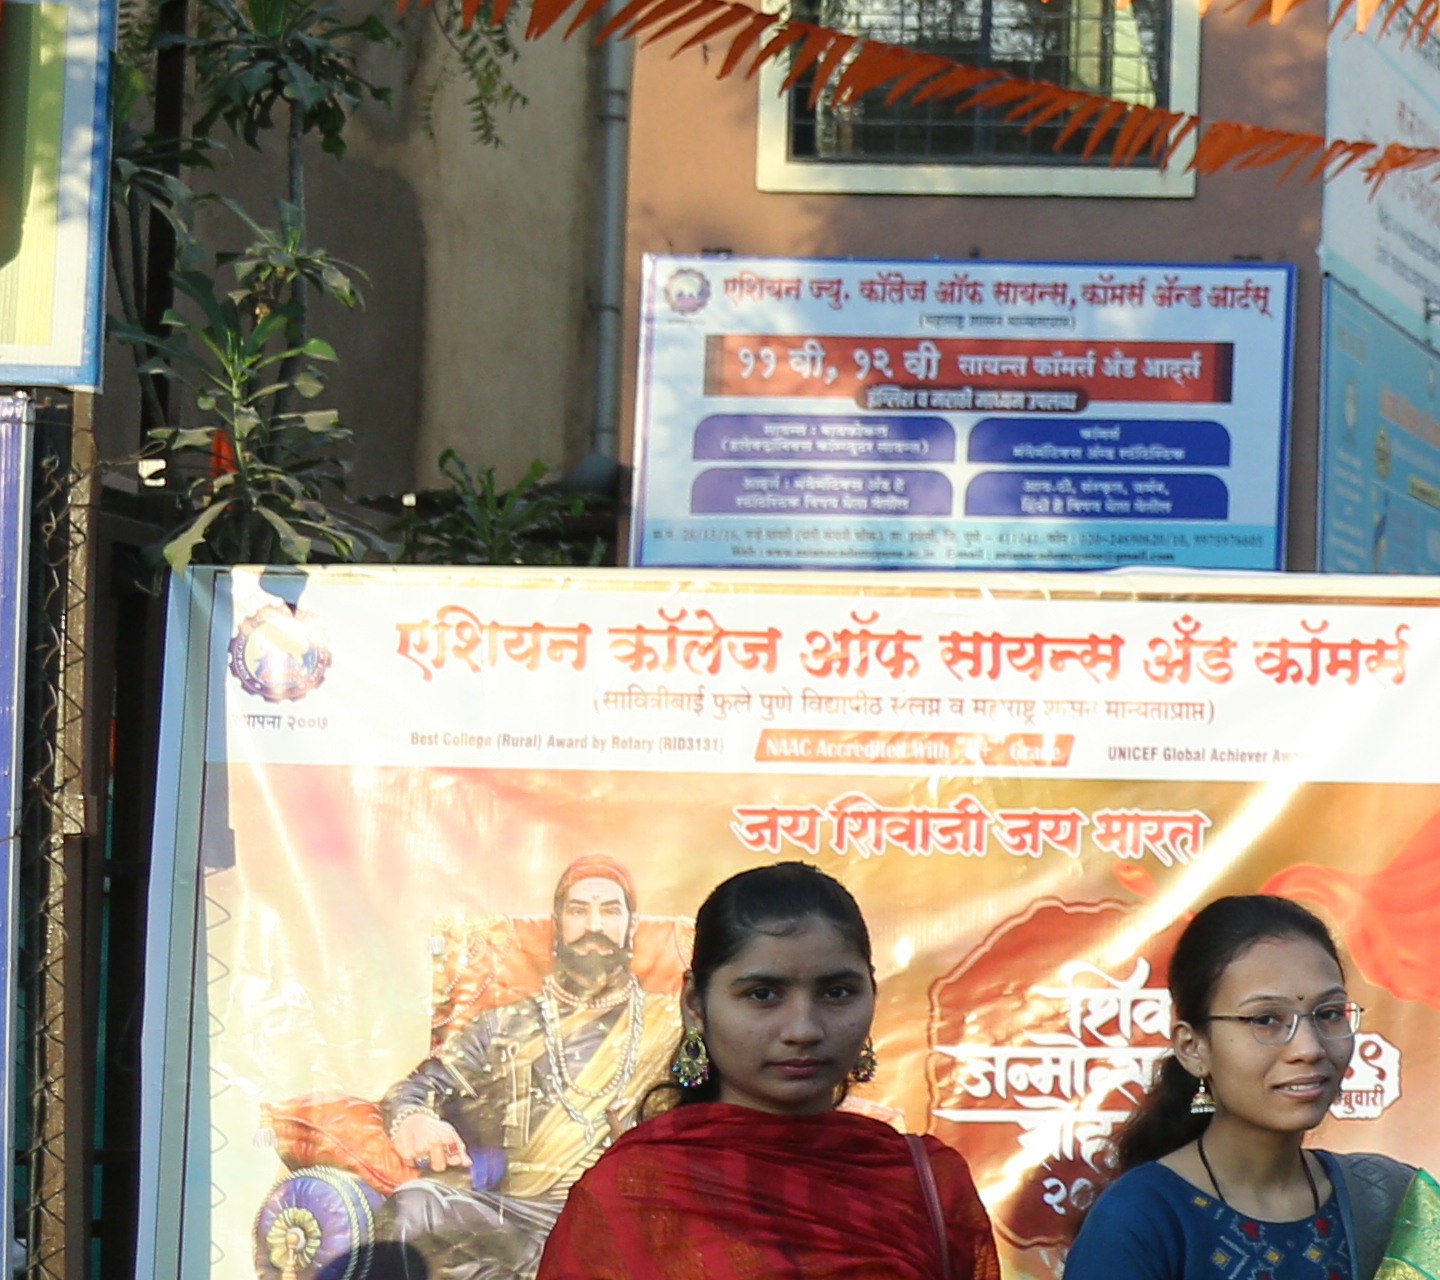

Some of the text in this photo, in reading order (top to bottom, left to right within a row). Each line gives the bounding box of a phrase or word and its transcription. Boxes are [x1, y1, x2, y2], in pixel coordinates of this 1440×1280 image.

[723, 270, 802, 308] एशियन
[395, 604, 592, 682] एशियन
[607, 607, 783, 675] कॉलेज
[799, 609, 923, 682] ऑफ
[939, 628, 1125, 685] सायन्स
[1252, 618, 1412, 687] कॉमर्स
[410, 730, 440, 748] Best
[442, 731, 492, 751] College
[495, 731, 543, 752] (Rural)
[546, 732, 589, 751] Award
[610, 734, 655, 754] Rotary
[1107, 745, 1267, 765] UNICEF Global Achiever
[733, 791, 1211, 865] जय शिवाजी जय भारत
